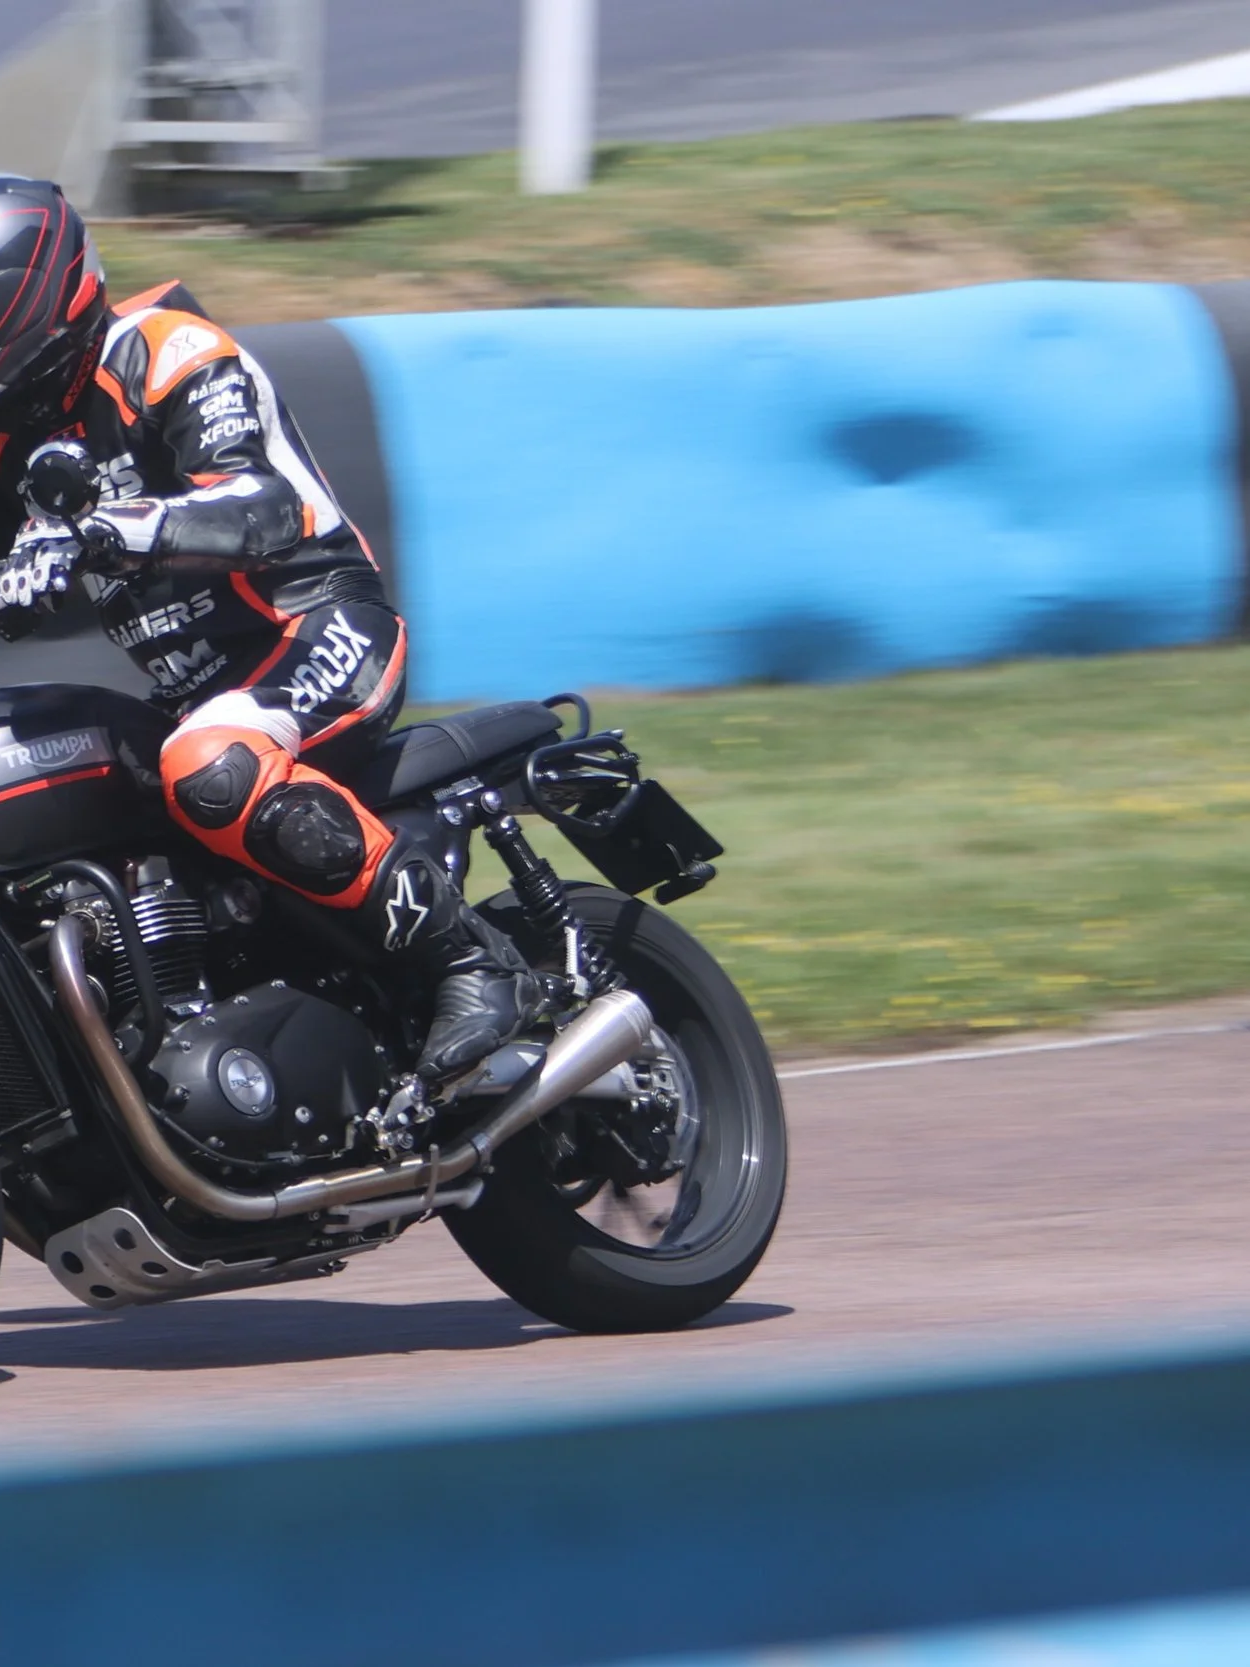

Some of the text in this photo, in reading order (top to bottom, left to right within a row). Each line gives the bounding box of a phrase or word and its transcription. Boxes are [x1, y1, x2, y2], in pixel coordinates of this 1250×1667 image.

[199, 417, 260, 450] XFOUR
[162, 654, 228, 699] CLEANER
[279, 609, 372, 713] XFOUR
[0, 732, 94, 769] TRIUMPH
